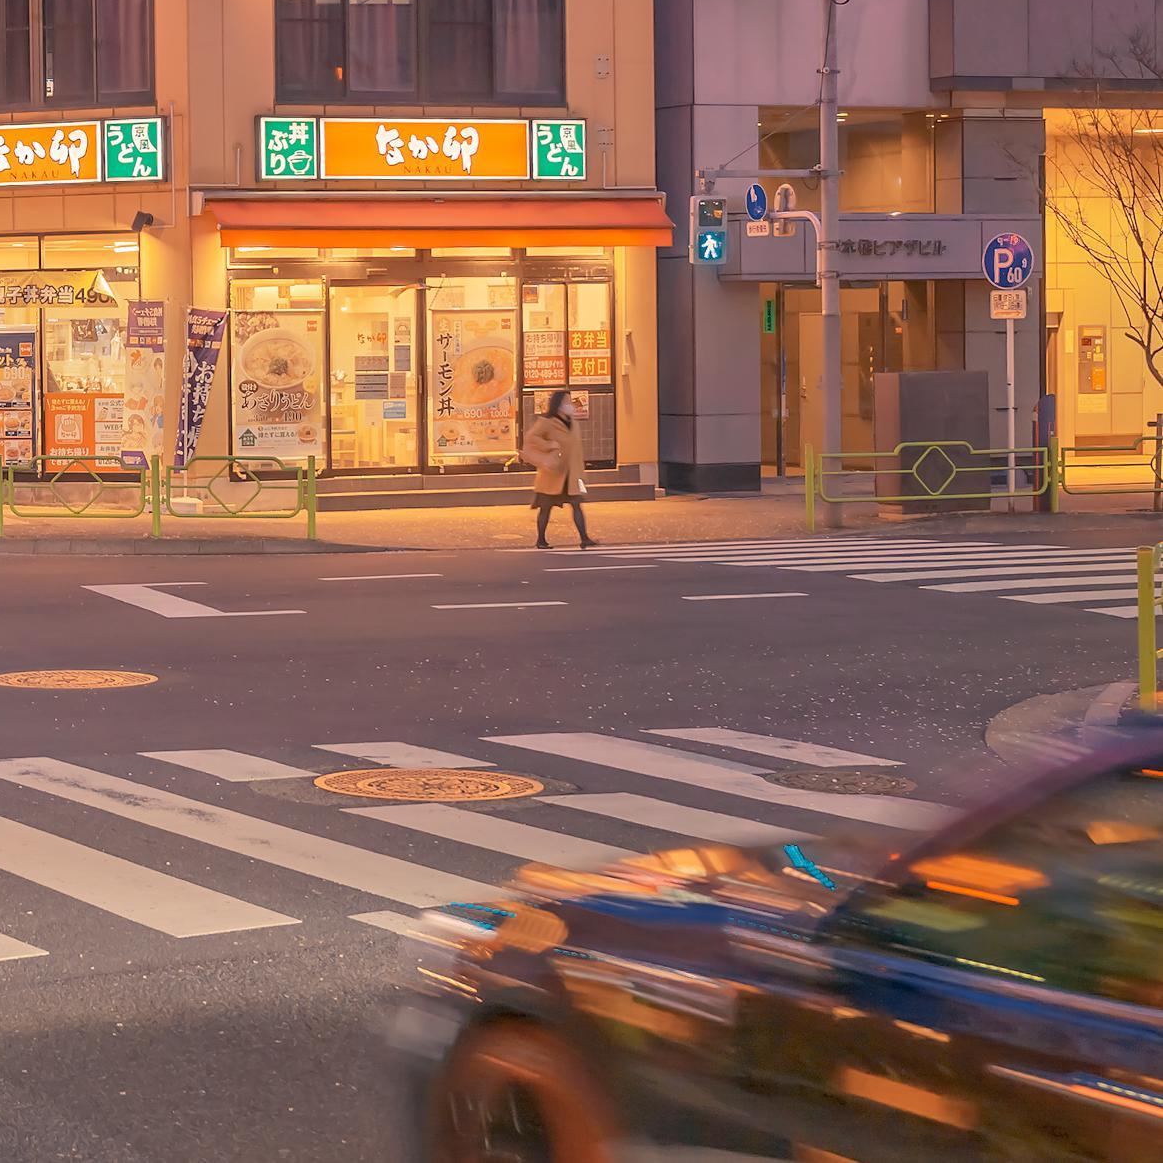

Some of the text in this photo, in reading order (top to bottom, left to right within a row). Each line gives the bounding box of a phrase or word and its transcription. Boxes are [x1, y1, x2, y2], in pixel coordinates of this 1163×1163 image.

[107, 125, 152, 178] うどん
[376, 124, 480, 175] なか卯
[537, 125, 579, 178] うどん
[9, 170, 61, 180] NAKAU
[403, 165, 453, 175] NAKAU
[834, 239, 947, 257] 本橋ピアザビル
[994, 248, 1014, 284] P
[572, 331, 607, 349] お弁当
[572, 358, 608, 376] 受付口
[241, 389, 316, 412] あさりうどん
